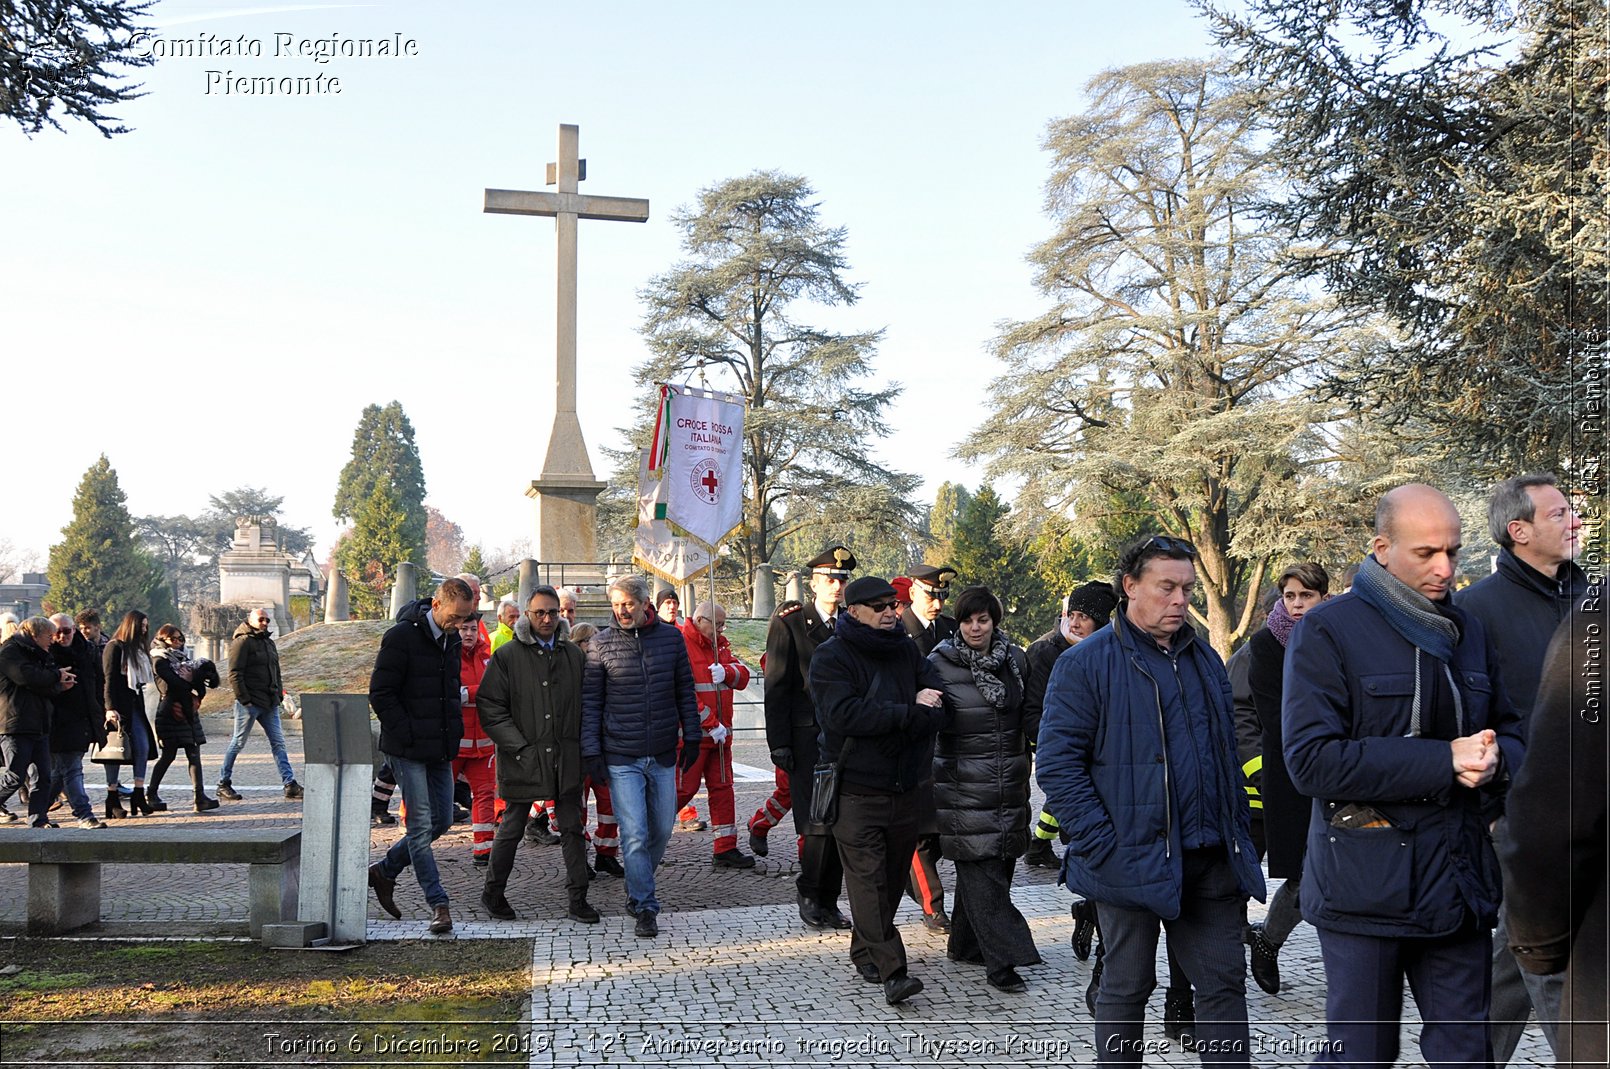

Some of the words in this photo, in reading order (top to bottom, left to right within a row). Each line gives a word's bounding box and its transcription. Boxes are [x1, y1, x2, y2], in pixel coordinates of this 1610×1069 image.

[676, 418, 708, 431] CROCE
[690, 432, 722, 447] ITALIANA
[684, 444, 711, 452] COMITATO
